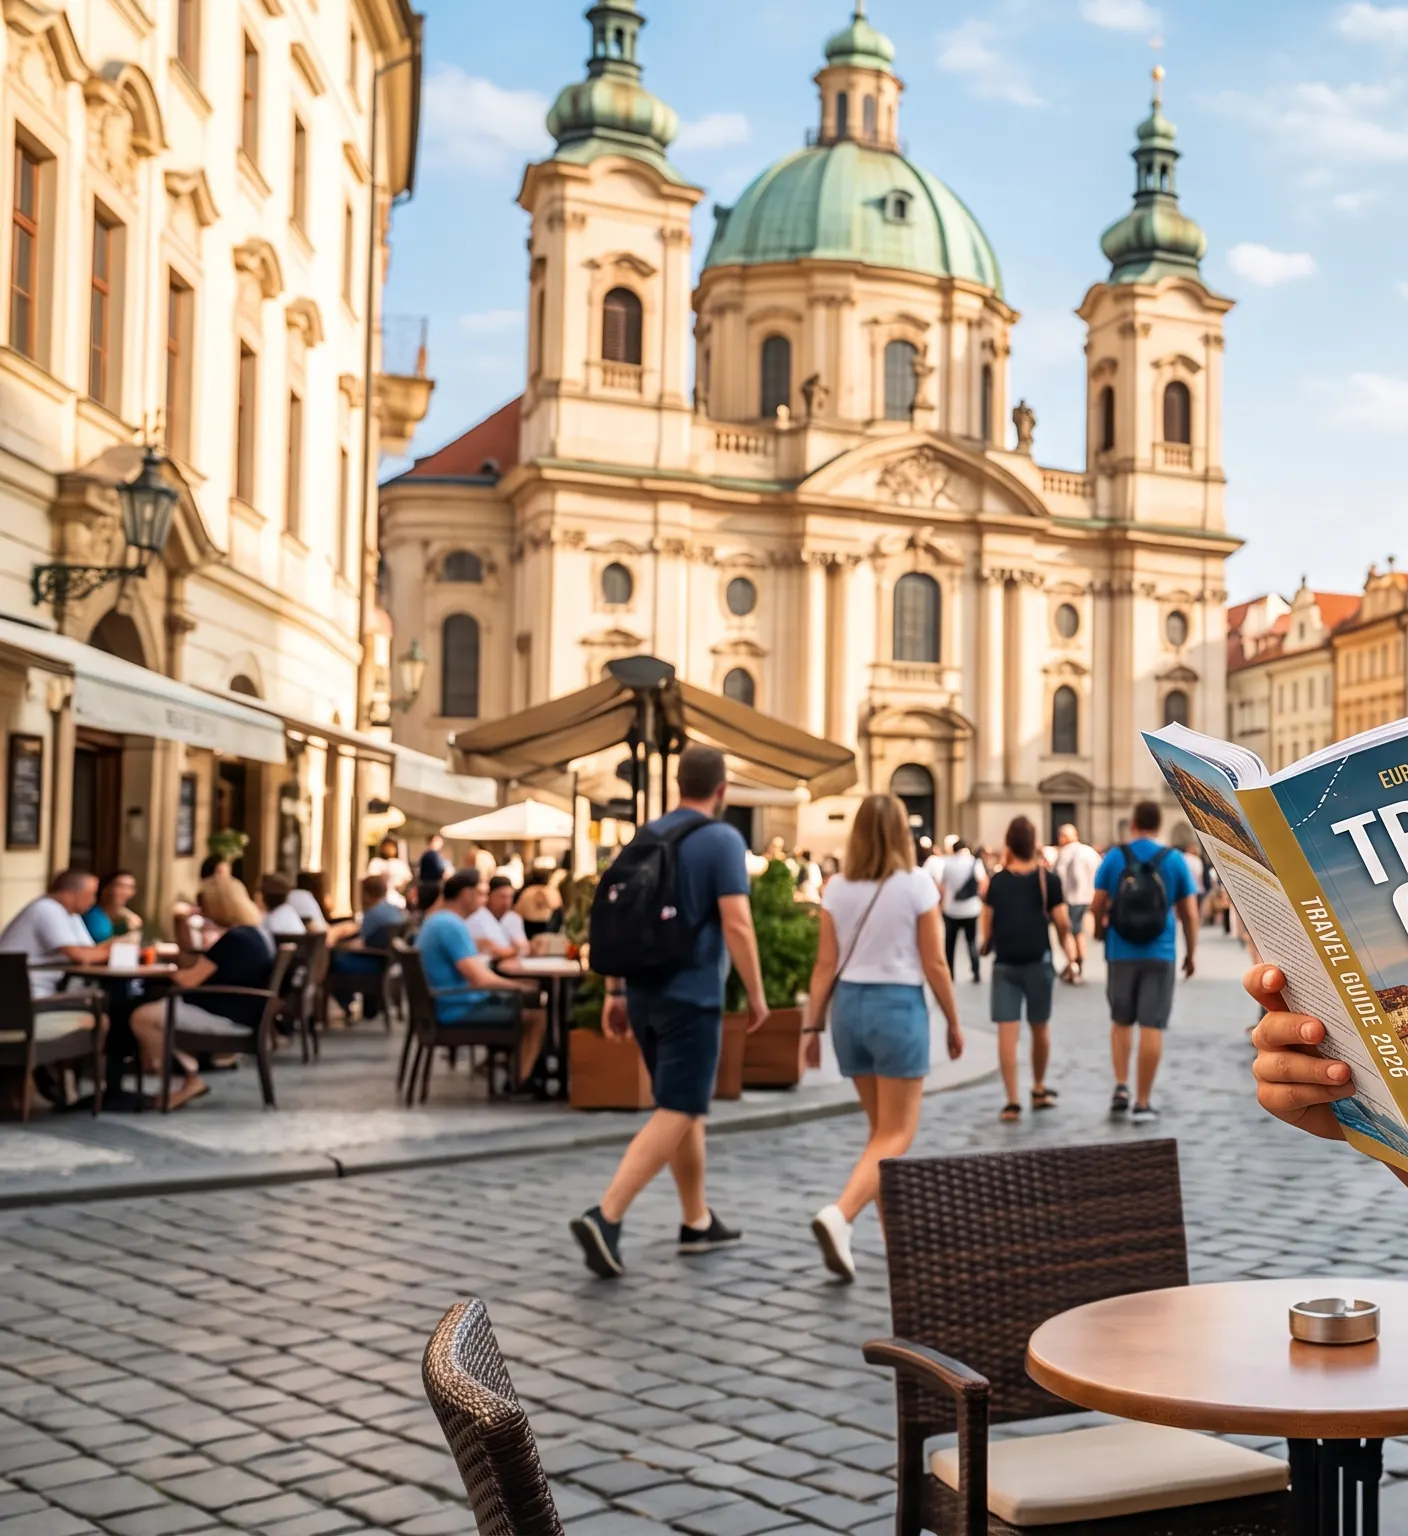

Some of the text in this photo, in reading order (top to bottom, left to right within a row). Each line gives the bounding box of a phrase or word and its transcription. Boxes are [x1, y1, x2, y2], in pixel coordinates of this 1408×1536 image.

[1300, 896, 1408, 1079] TRAVEL GUIDE 2026
